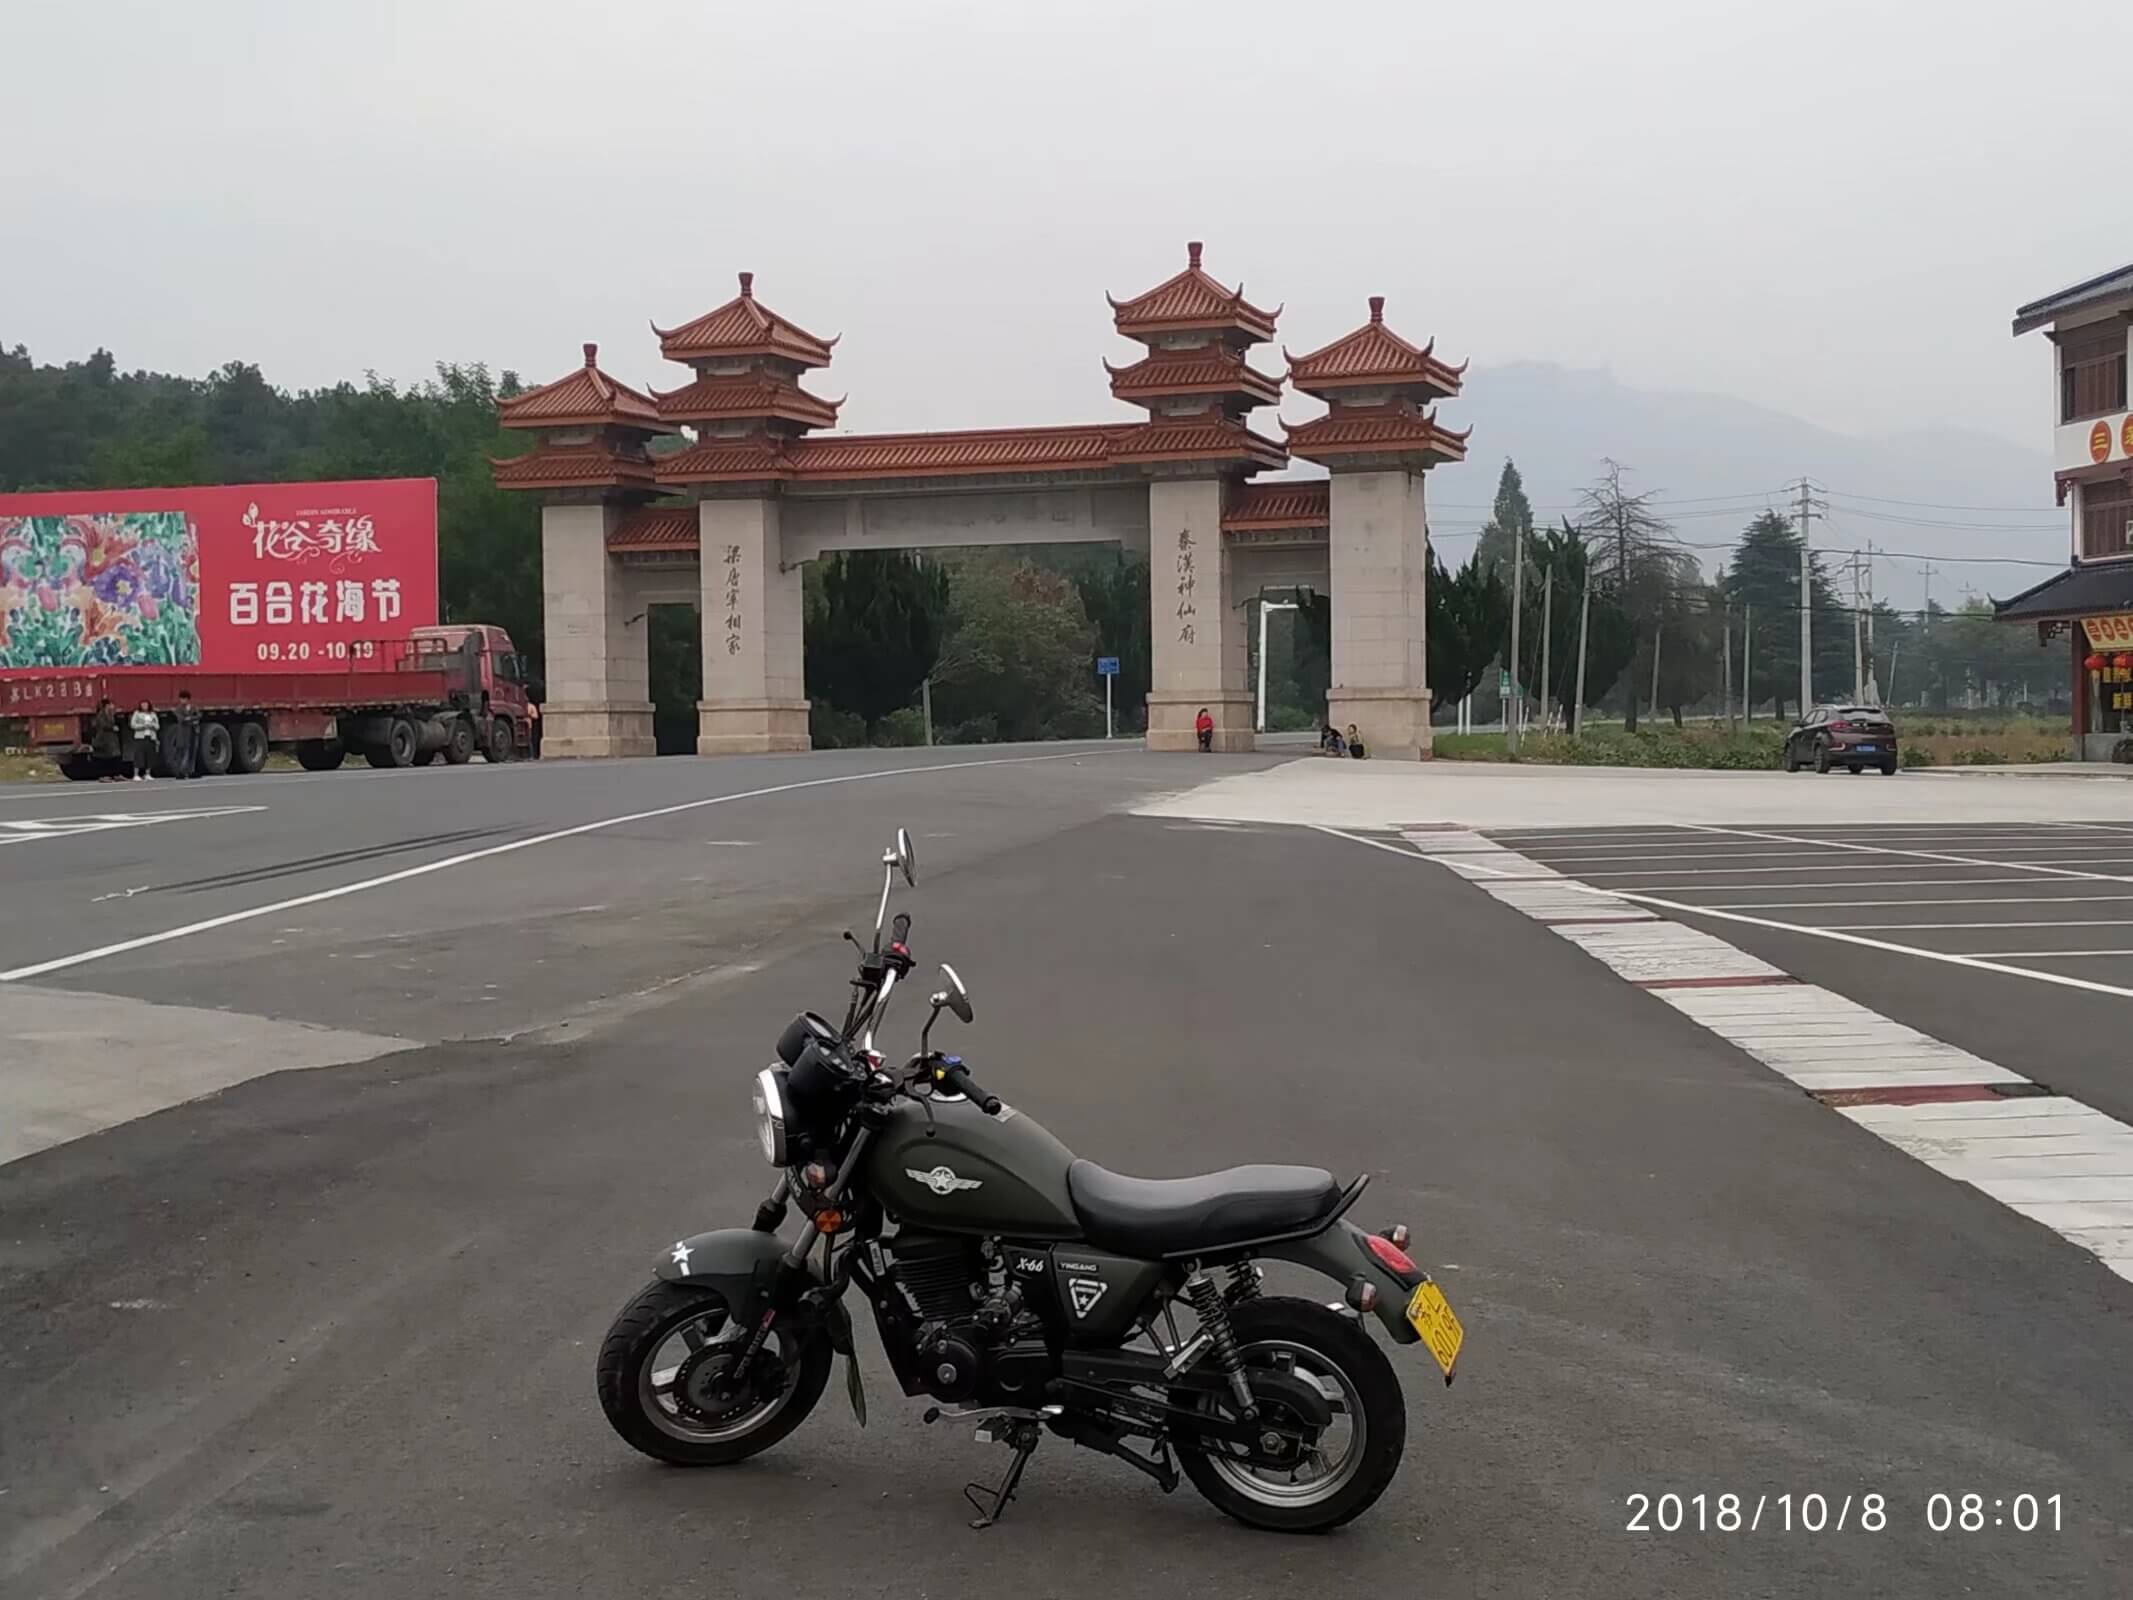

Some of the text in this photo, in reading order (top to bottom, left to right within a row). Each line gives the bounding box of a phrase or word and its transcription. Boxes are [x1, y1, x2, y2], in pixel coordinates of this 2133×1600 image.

[250, 515, 382, 559] 花谷奇缘
[229, 578, 401, 625] 百合花海节
[257, 642, 310, 660] 09.20
[1016, 1257, 1044, 1272] X-66
[1060, 1262, 1097, 1271] YINGANG
